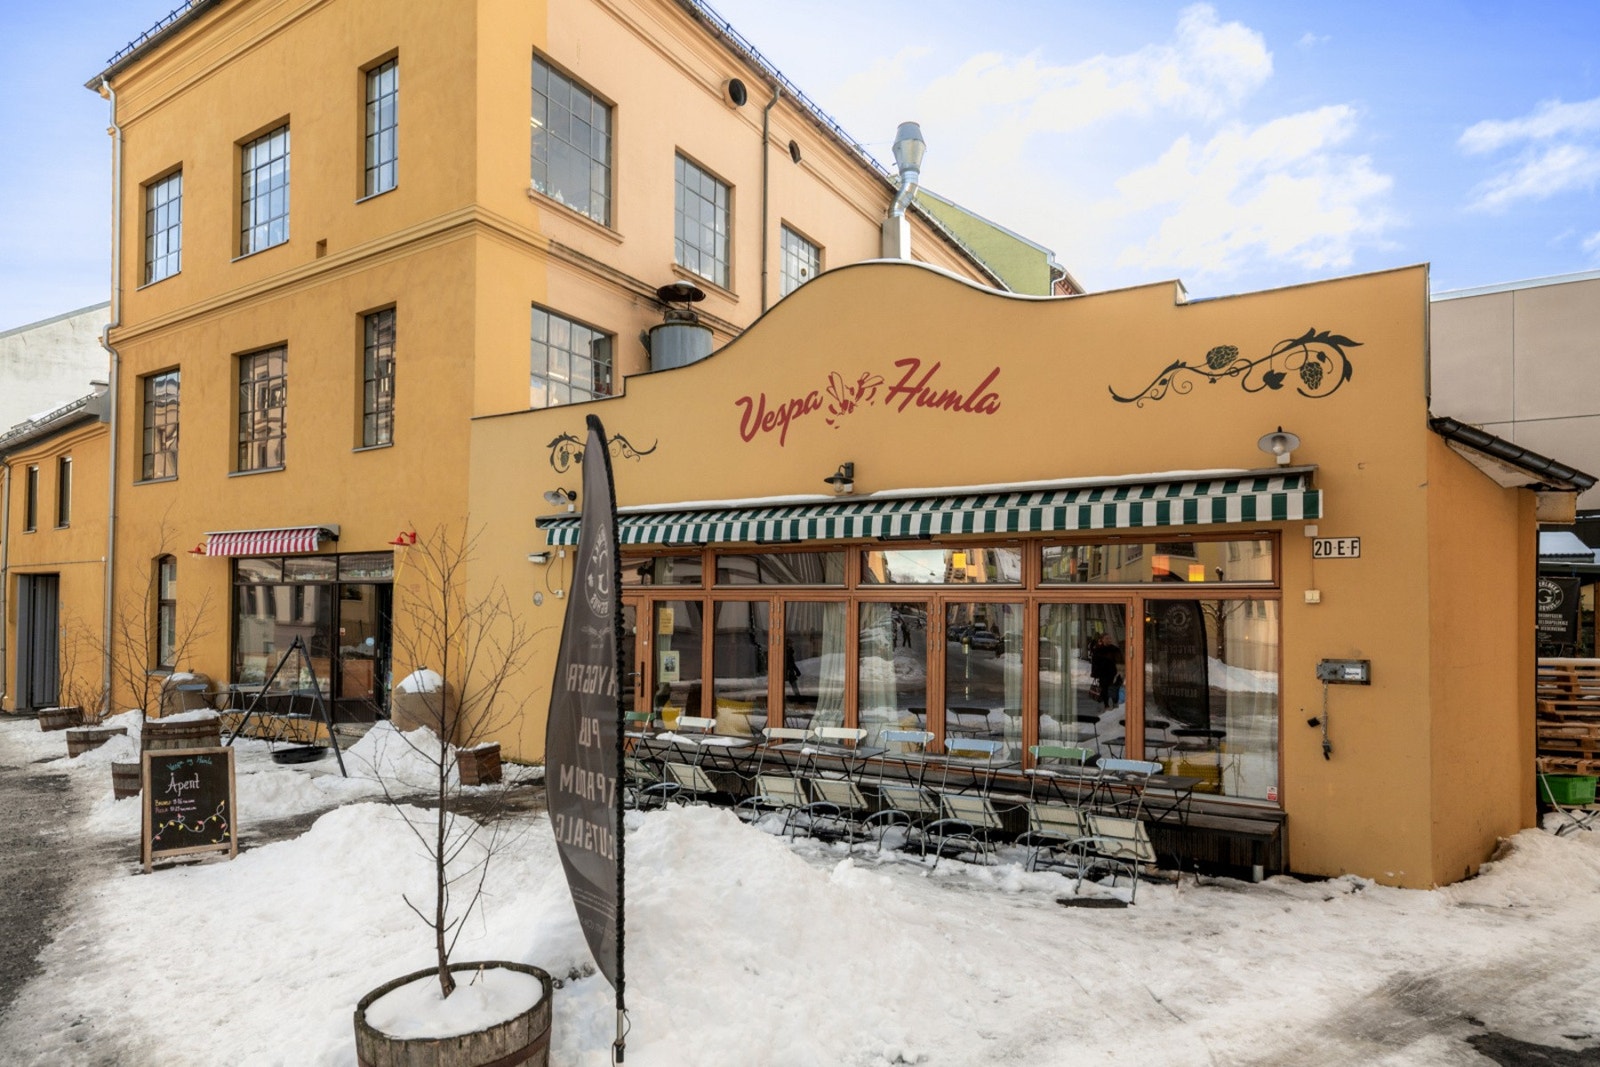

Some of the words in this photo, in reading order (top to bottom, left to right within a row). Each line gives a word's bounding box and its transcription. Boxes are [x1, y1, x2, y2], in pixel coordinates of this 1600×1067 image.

[735, 390, 824, 447] Vespa
[885, 358, 1001, 415] Humla
[165, 772, 200, 797] Åpent
